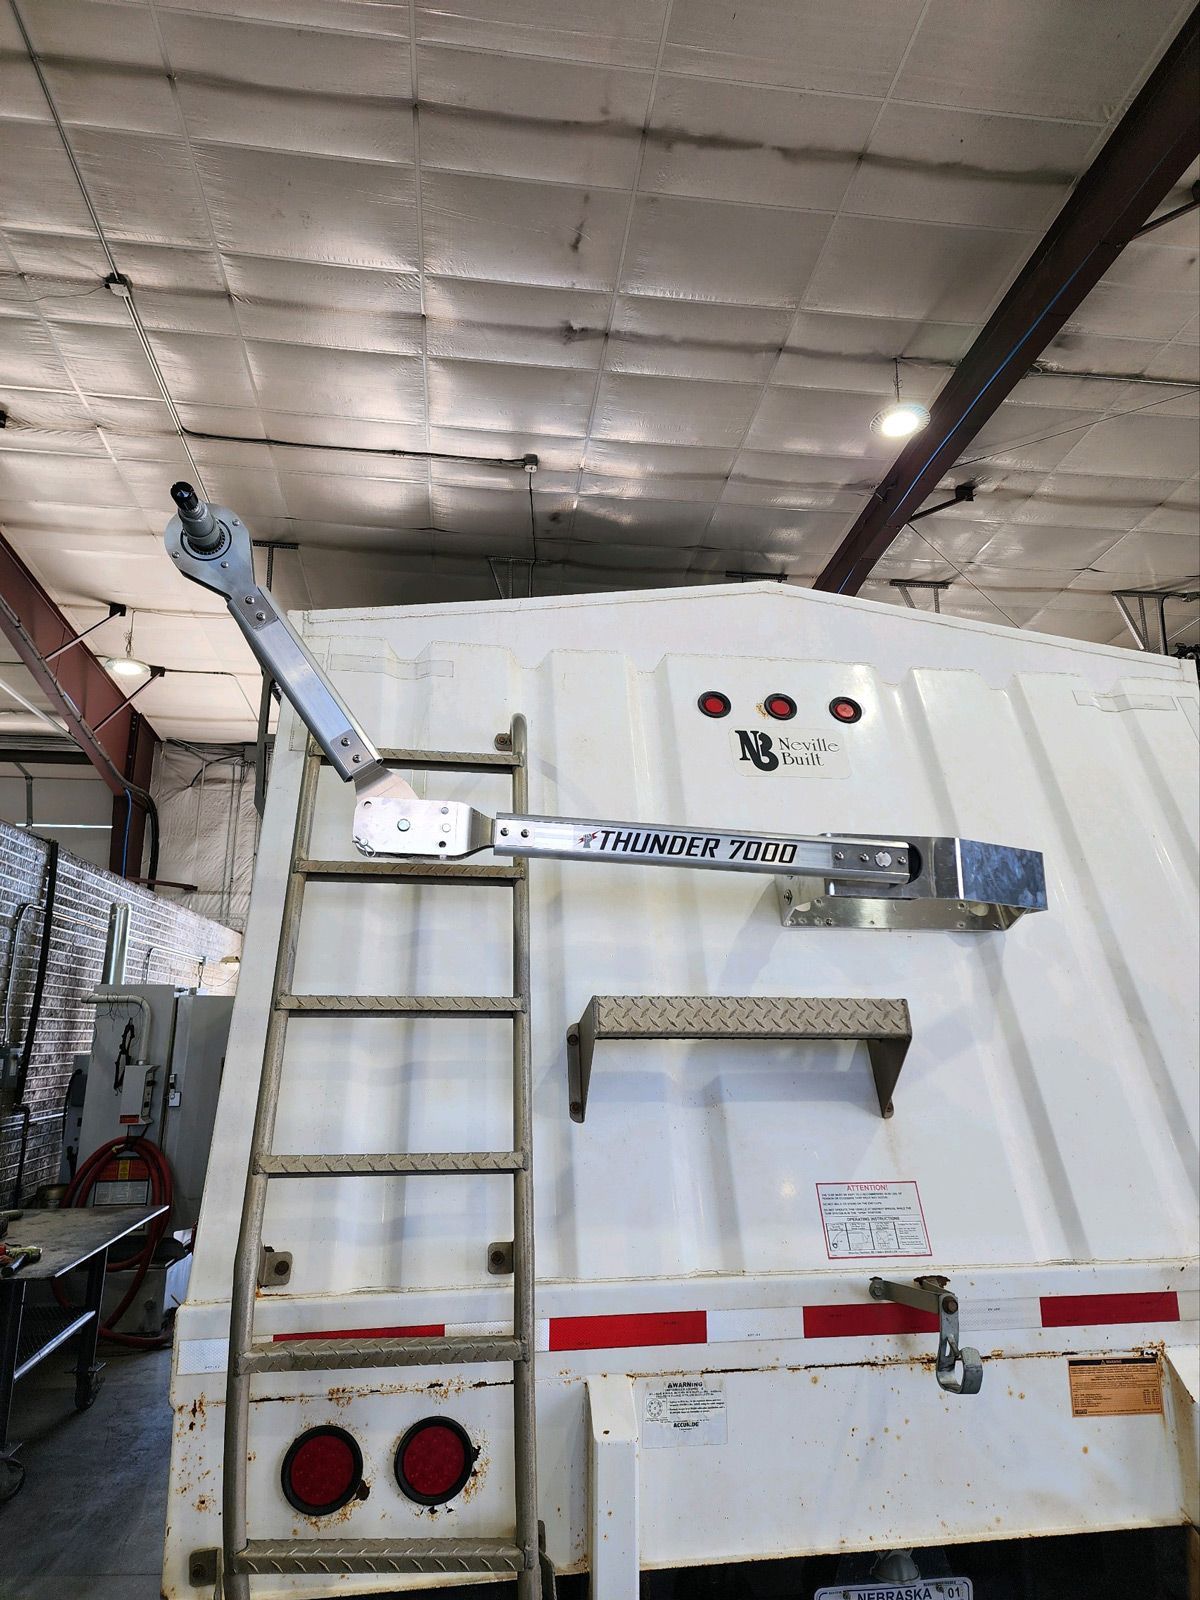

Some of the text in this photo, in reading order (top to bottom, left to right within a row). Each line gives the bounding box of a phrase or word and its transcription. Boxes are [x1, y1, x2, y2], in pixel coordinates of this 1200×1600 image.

[778, 737, 840, 752] Neville
[782, 752, 824, 767] Built
[599, 831, 797, 864] THUNDER 7000
[857, 1587, 960, 1600] NEBRASKA 01
